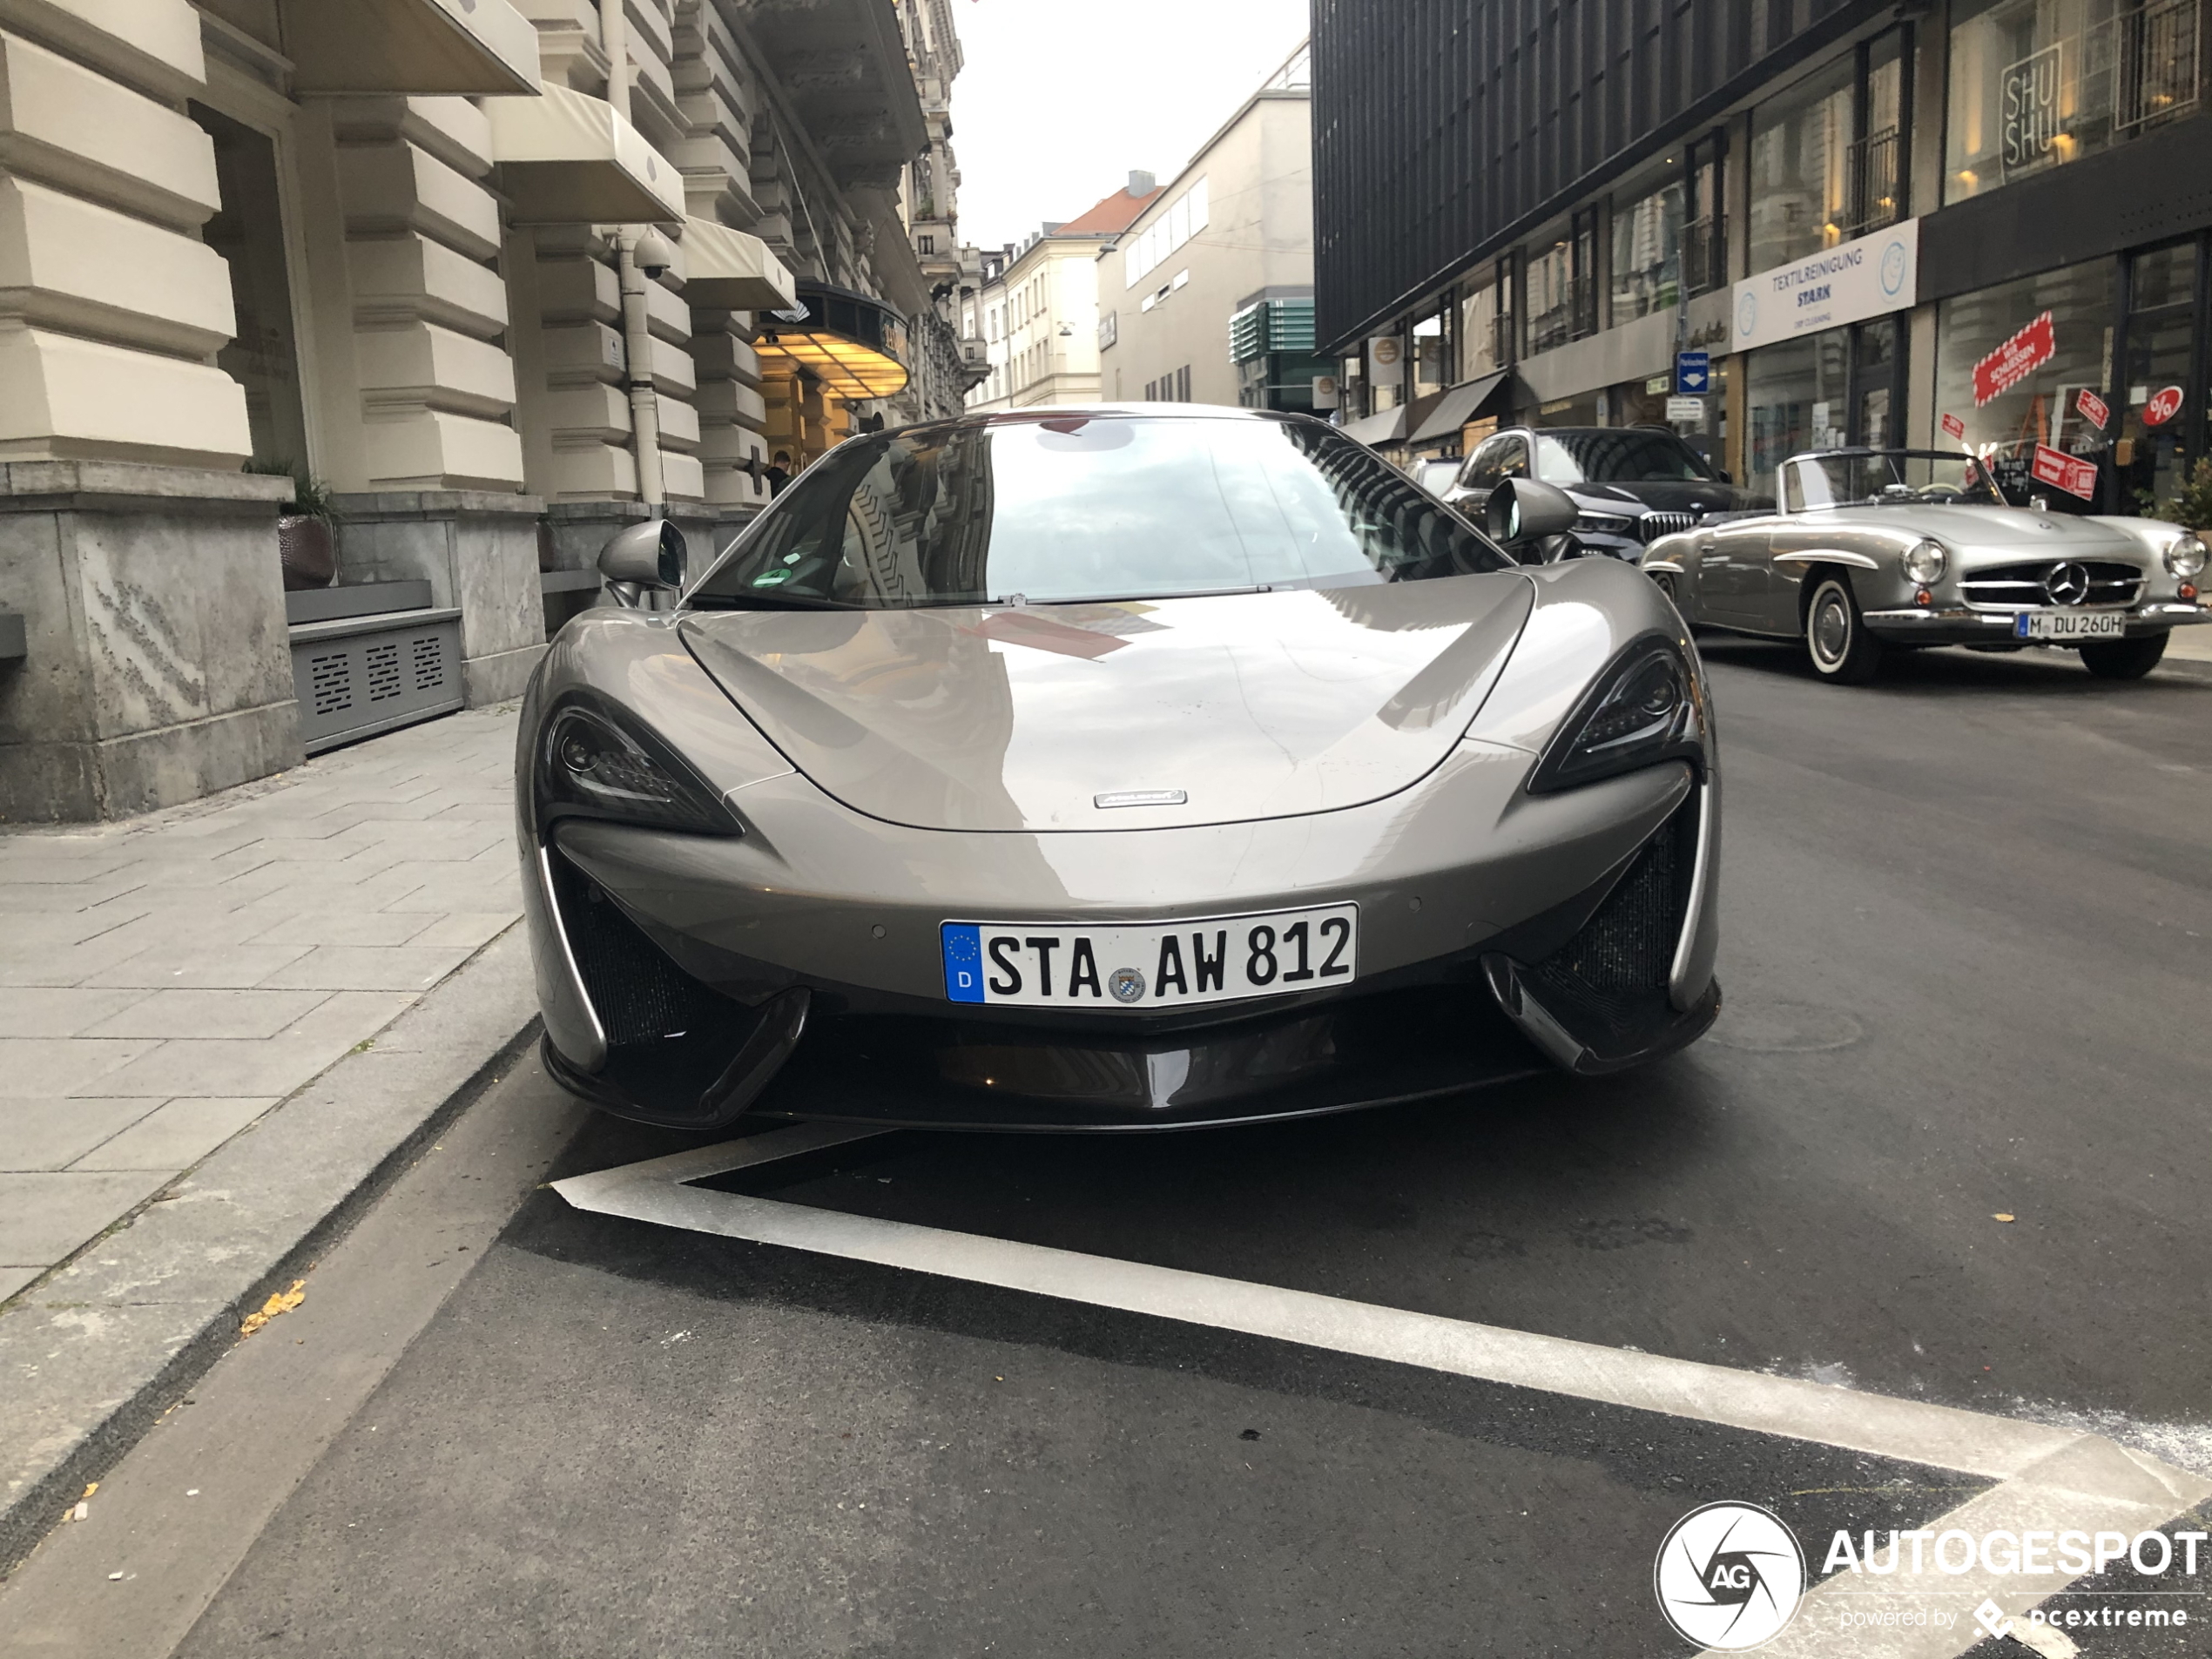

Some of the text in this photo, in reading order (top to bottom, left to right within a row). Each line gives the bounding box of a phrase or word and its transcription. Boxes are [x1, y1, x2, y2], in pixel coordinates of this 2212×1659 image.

[2006, 59, 2054, 120] SHU
[2006, 106, 2054, 165] SHU
[1772, 248, 1863, 293] TEXTILREINIGUNG
[1797, 285, 1831, 307] STARK
[1990, 342, 2036, 383] SCHLIESSEN
[2004, 343, 2018, 360] WIR
[2149, 395, 2172, 421] %
[2030, 616, 2123, 634] M DU 260H
[988, 936, 1102, 998] STA
[1155, 929, 1227, 998] AW
[1246, 917, 1350, 986] 812
[958, 971, 972, 988] D
